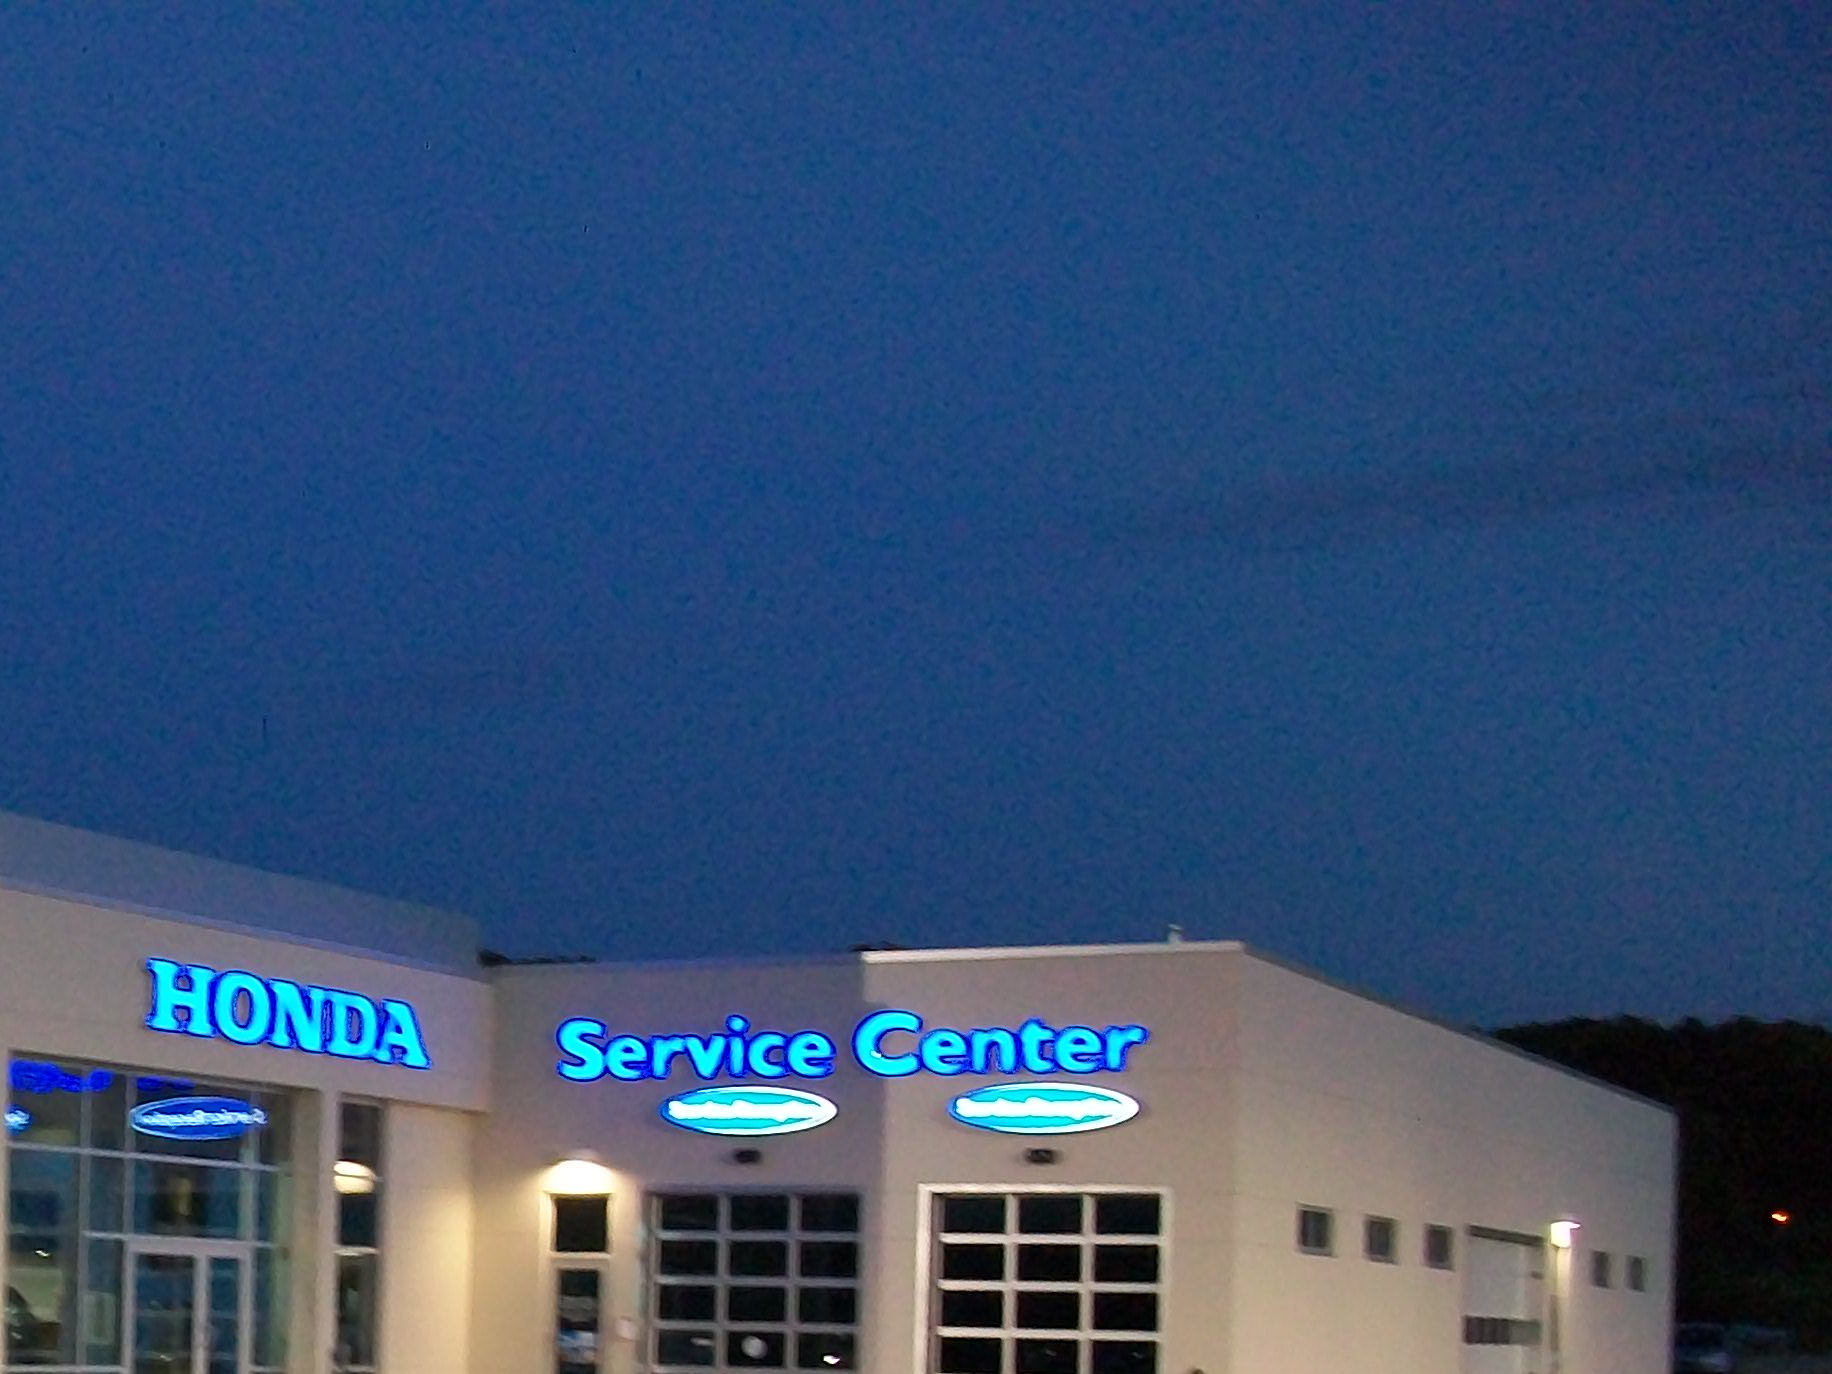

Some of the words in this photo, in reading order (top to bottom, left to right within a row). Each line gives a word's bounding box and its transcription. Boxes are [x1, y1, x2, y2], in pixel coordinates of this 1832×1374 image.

[144, 956, 432, 1071] HONDA
[556, 1014, 837, 1082] Service
[851, 1008, 1149, 1078] Center
